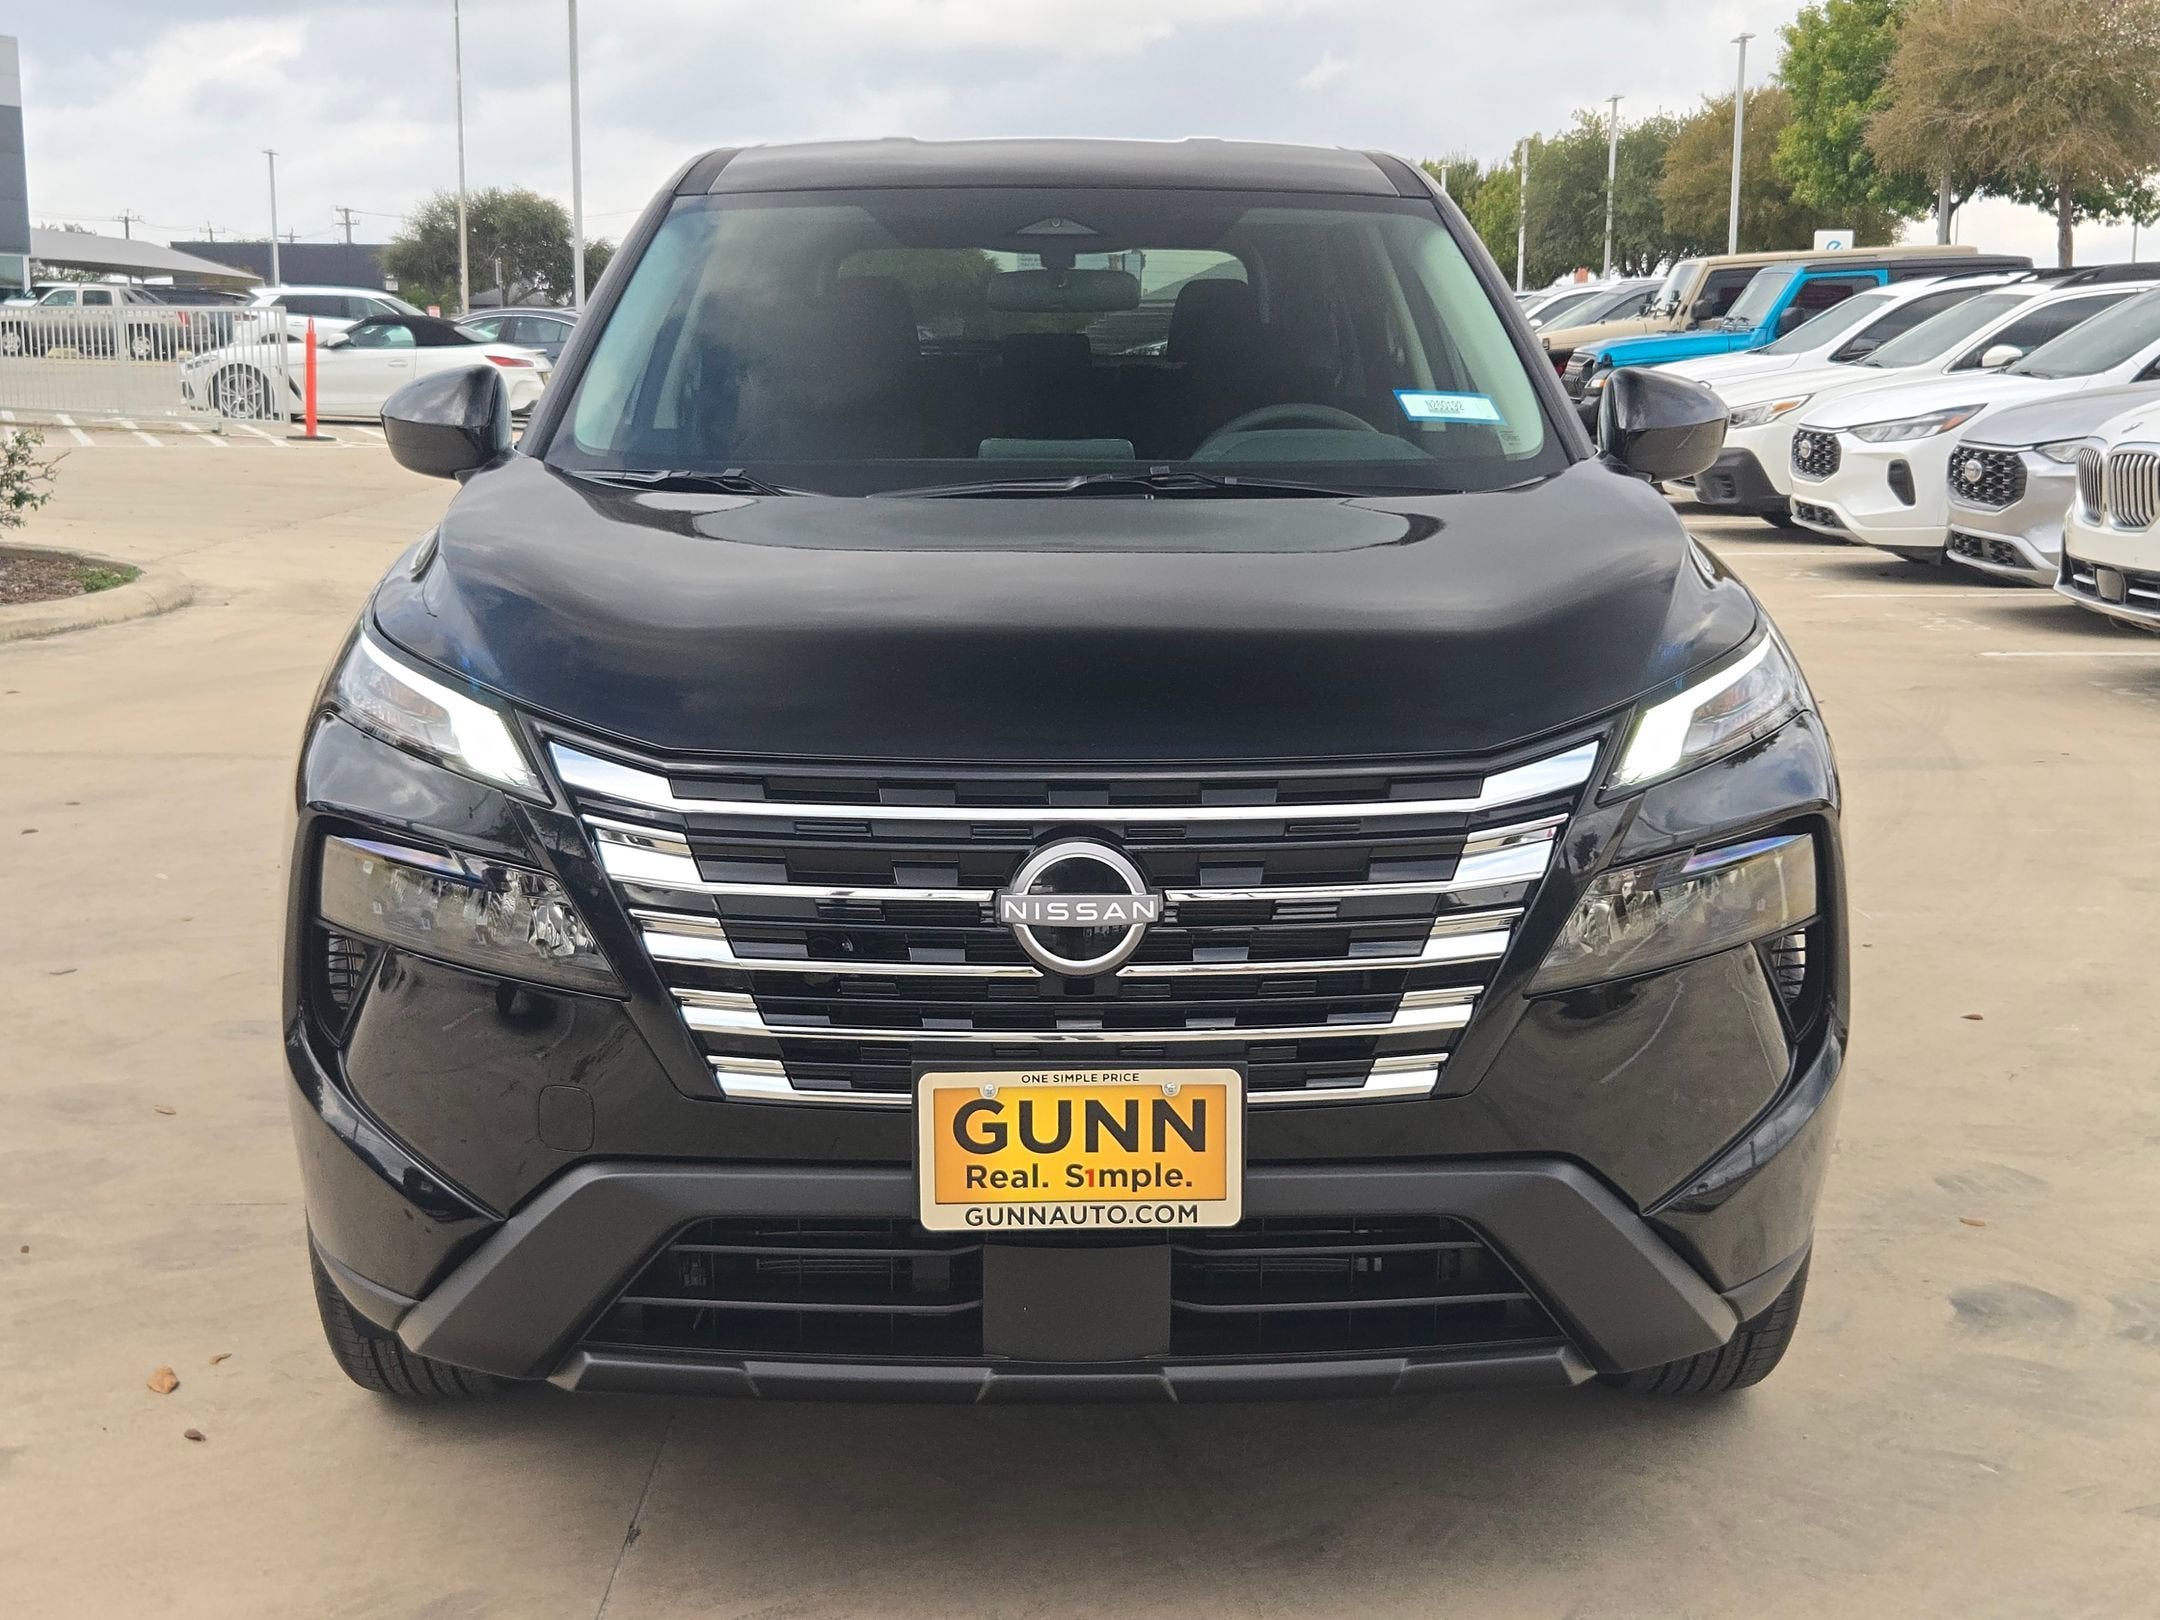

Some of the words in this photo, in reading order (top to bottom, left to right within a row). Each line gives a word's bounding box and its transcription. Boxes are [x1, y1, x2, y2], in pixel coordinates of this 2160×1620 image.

[1004, 900, 1155, 921] NISSAN
[1021, 1074, 1048, 1084] ONE
[1052, 1073, 1098, 1083] SIMPLE
[1102, 1072, 1140, 1082] PRICE
[952, 1098, 1206, 1155] GUNN
[966, 1163, 1049, 1189] Real.
[1065, 1162, 1193, 1192] S1mple.
[965, 1204, 1198, 1227] GUNNAUTO.COM
